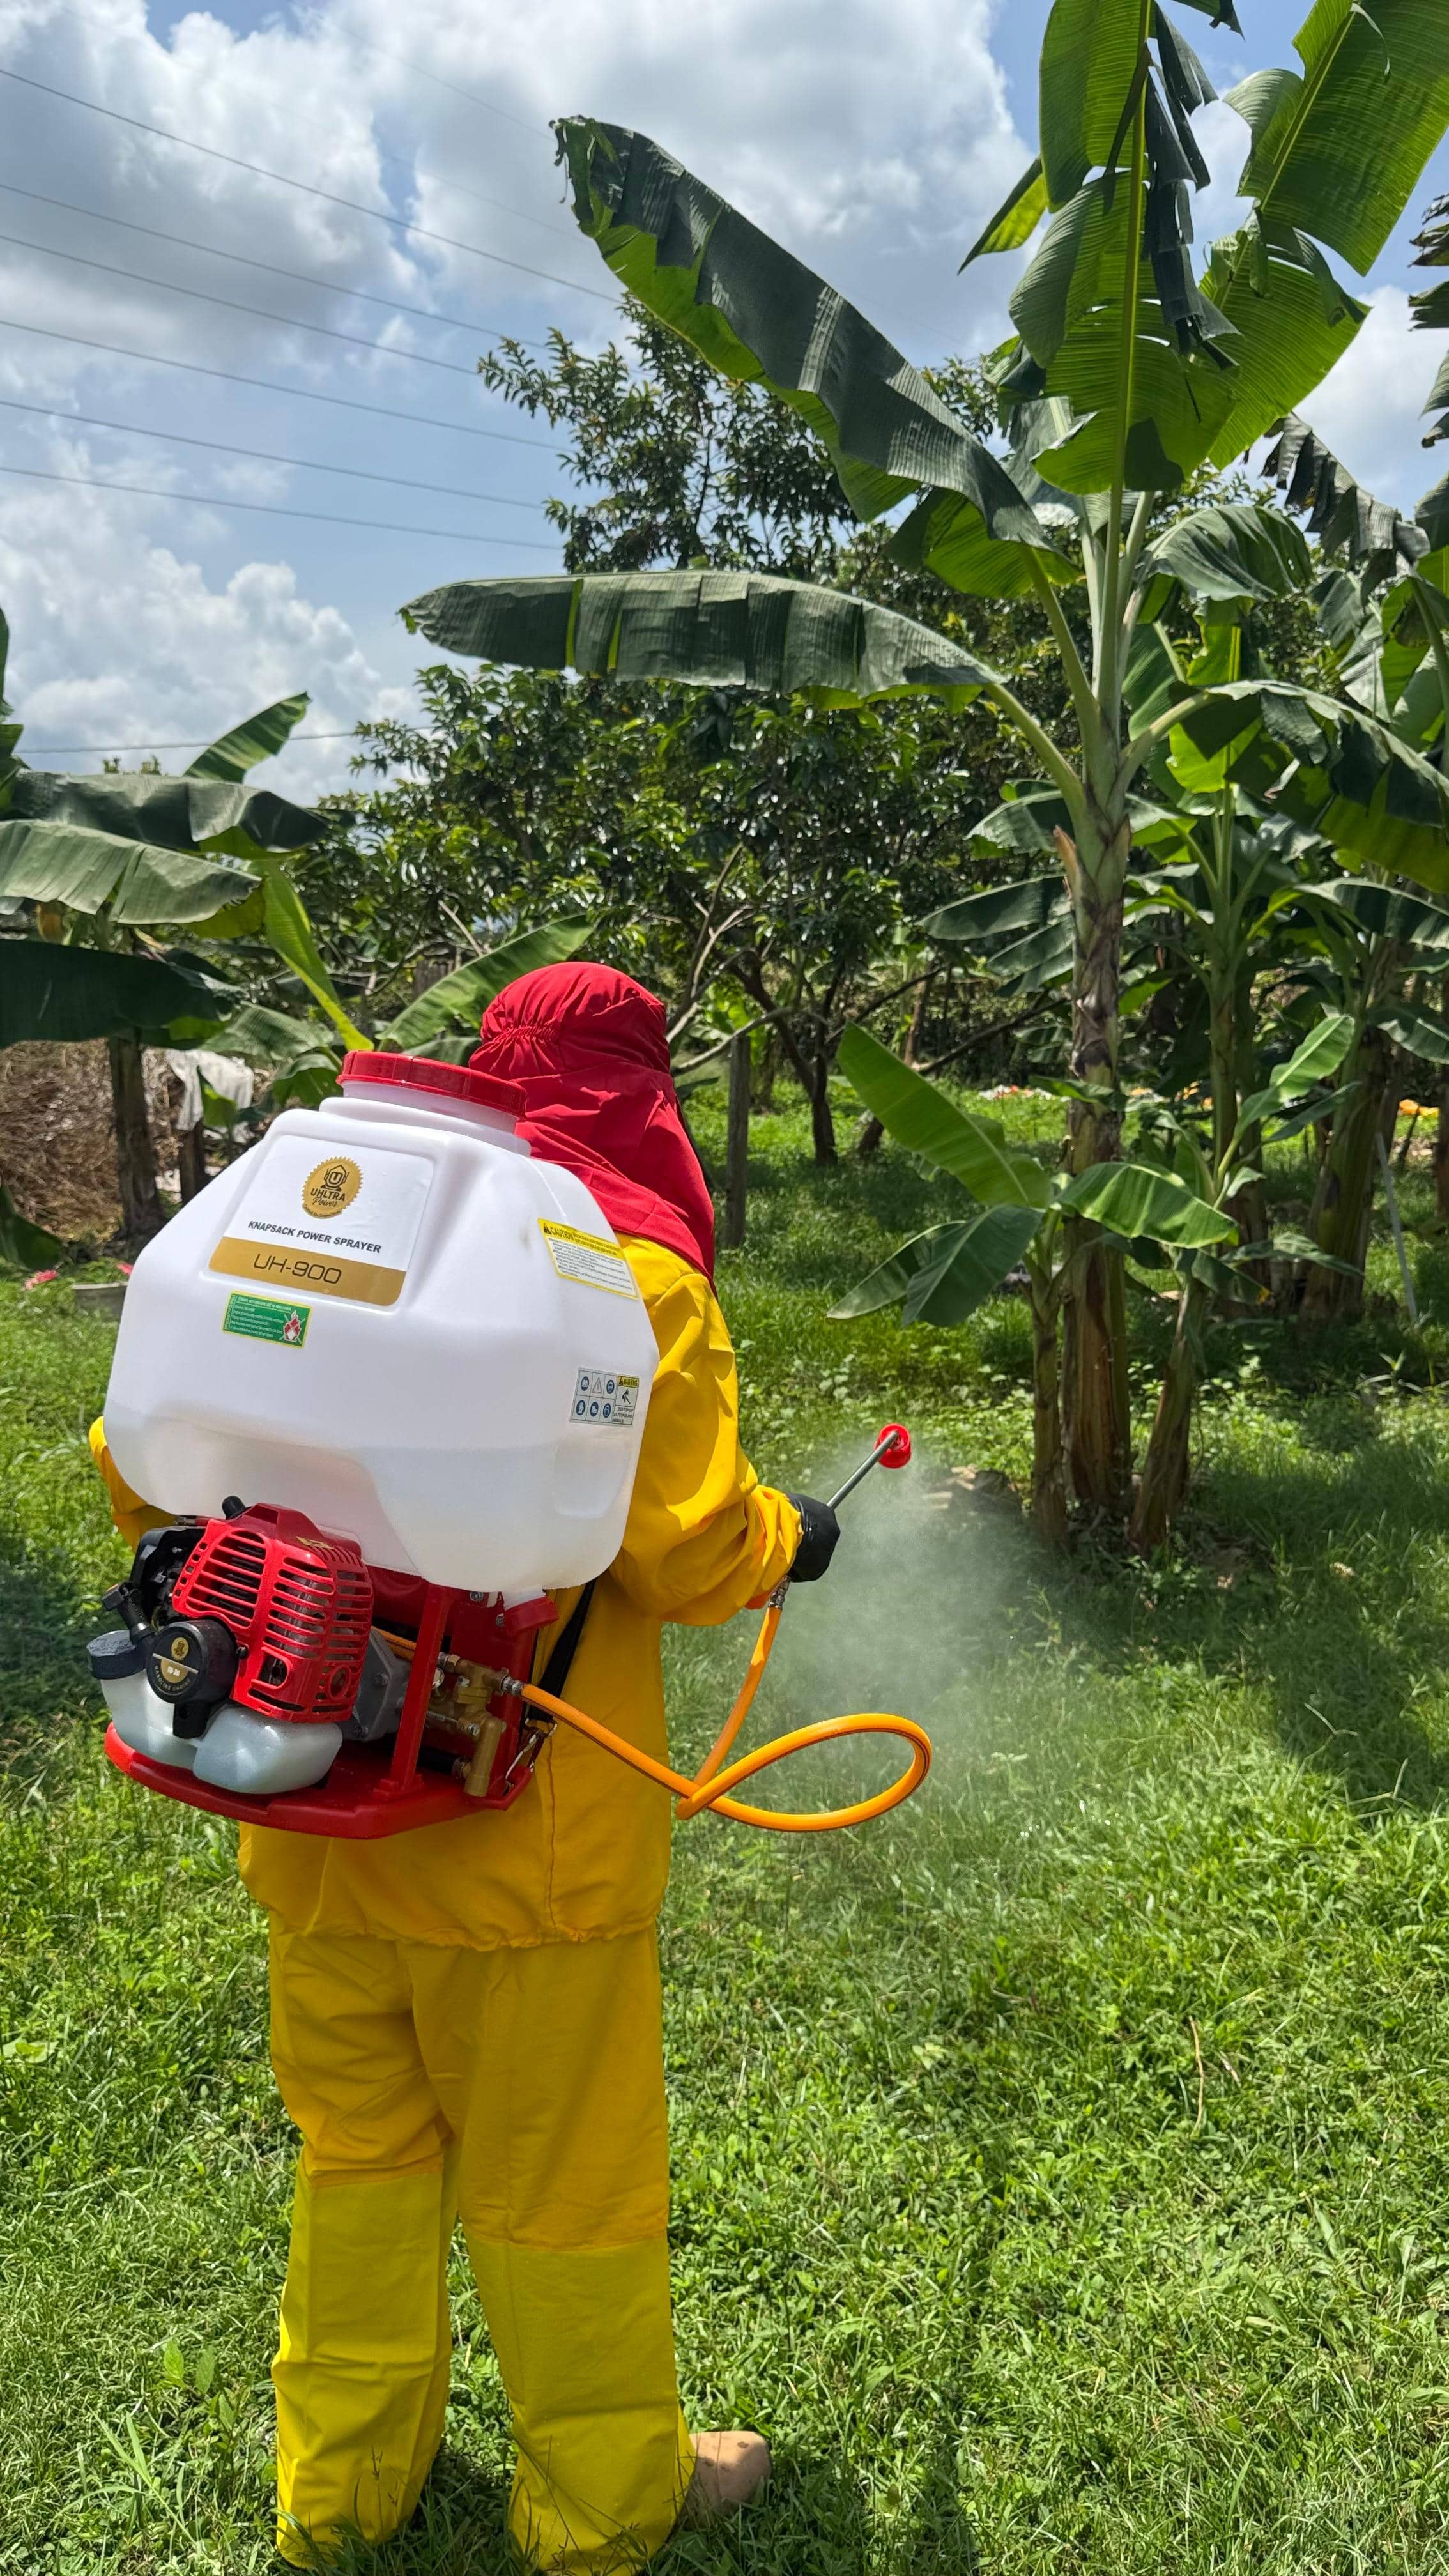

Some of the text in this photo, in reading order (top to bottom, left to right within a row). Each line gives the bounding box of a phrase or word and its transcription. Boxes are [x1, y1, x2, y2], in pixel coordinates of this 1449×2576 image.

[310, 1188, 346, 1202] UHLTRA
[312, 1197, 338, 1207] Power
[248, 1220, 382, 1254] KNAPSACK POWER SPRAYER
[550, 1226, 574, 1241] CAUTION
[254, 1254, 342, 1284] UH-900
